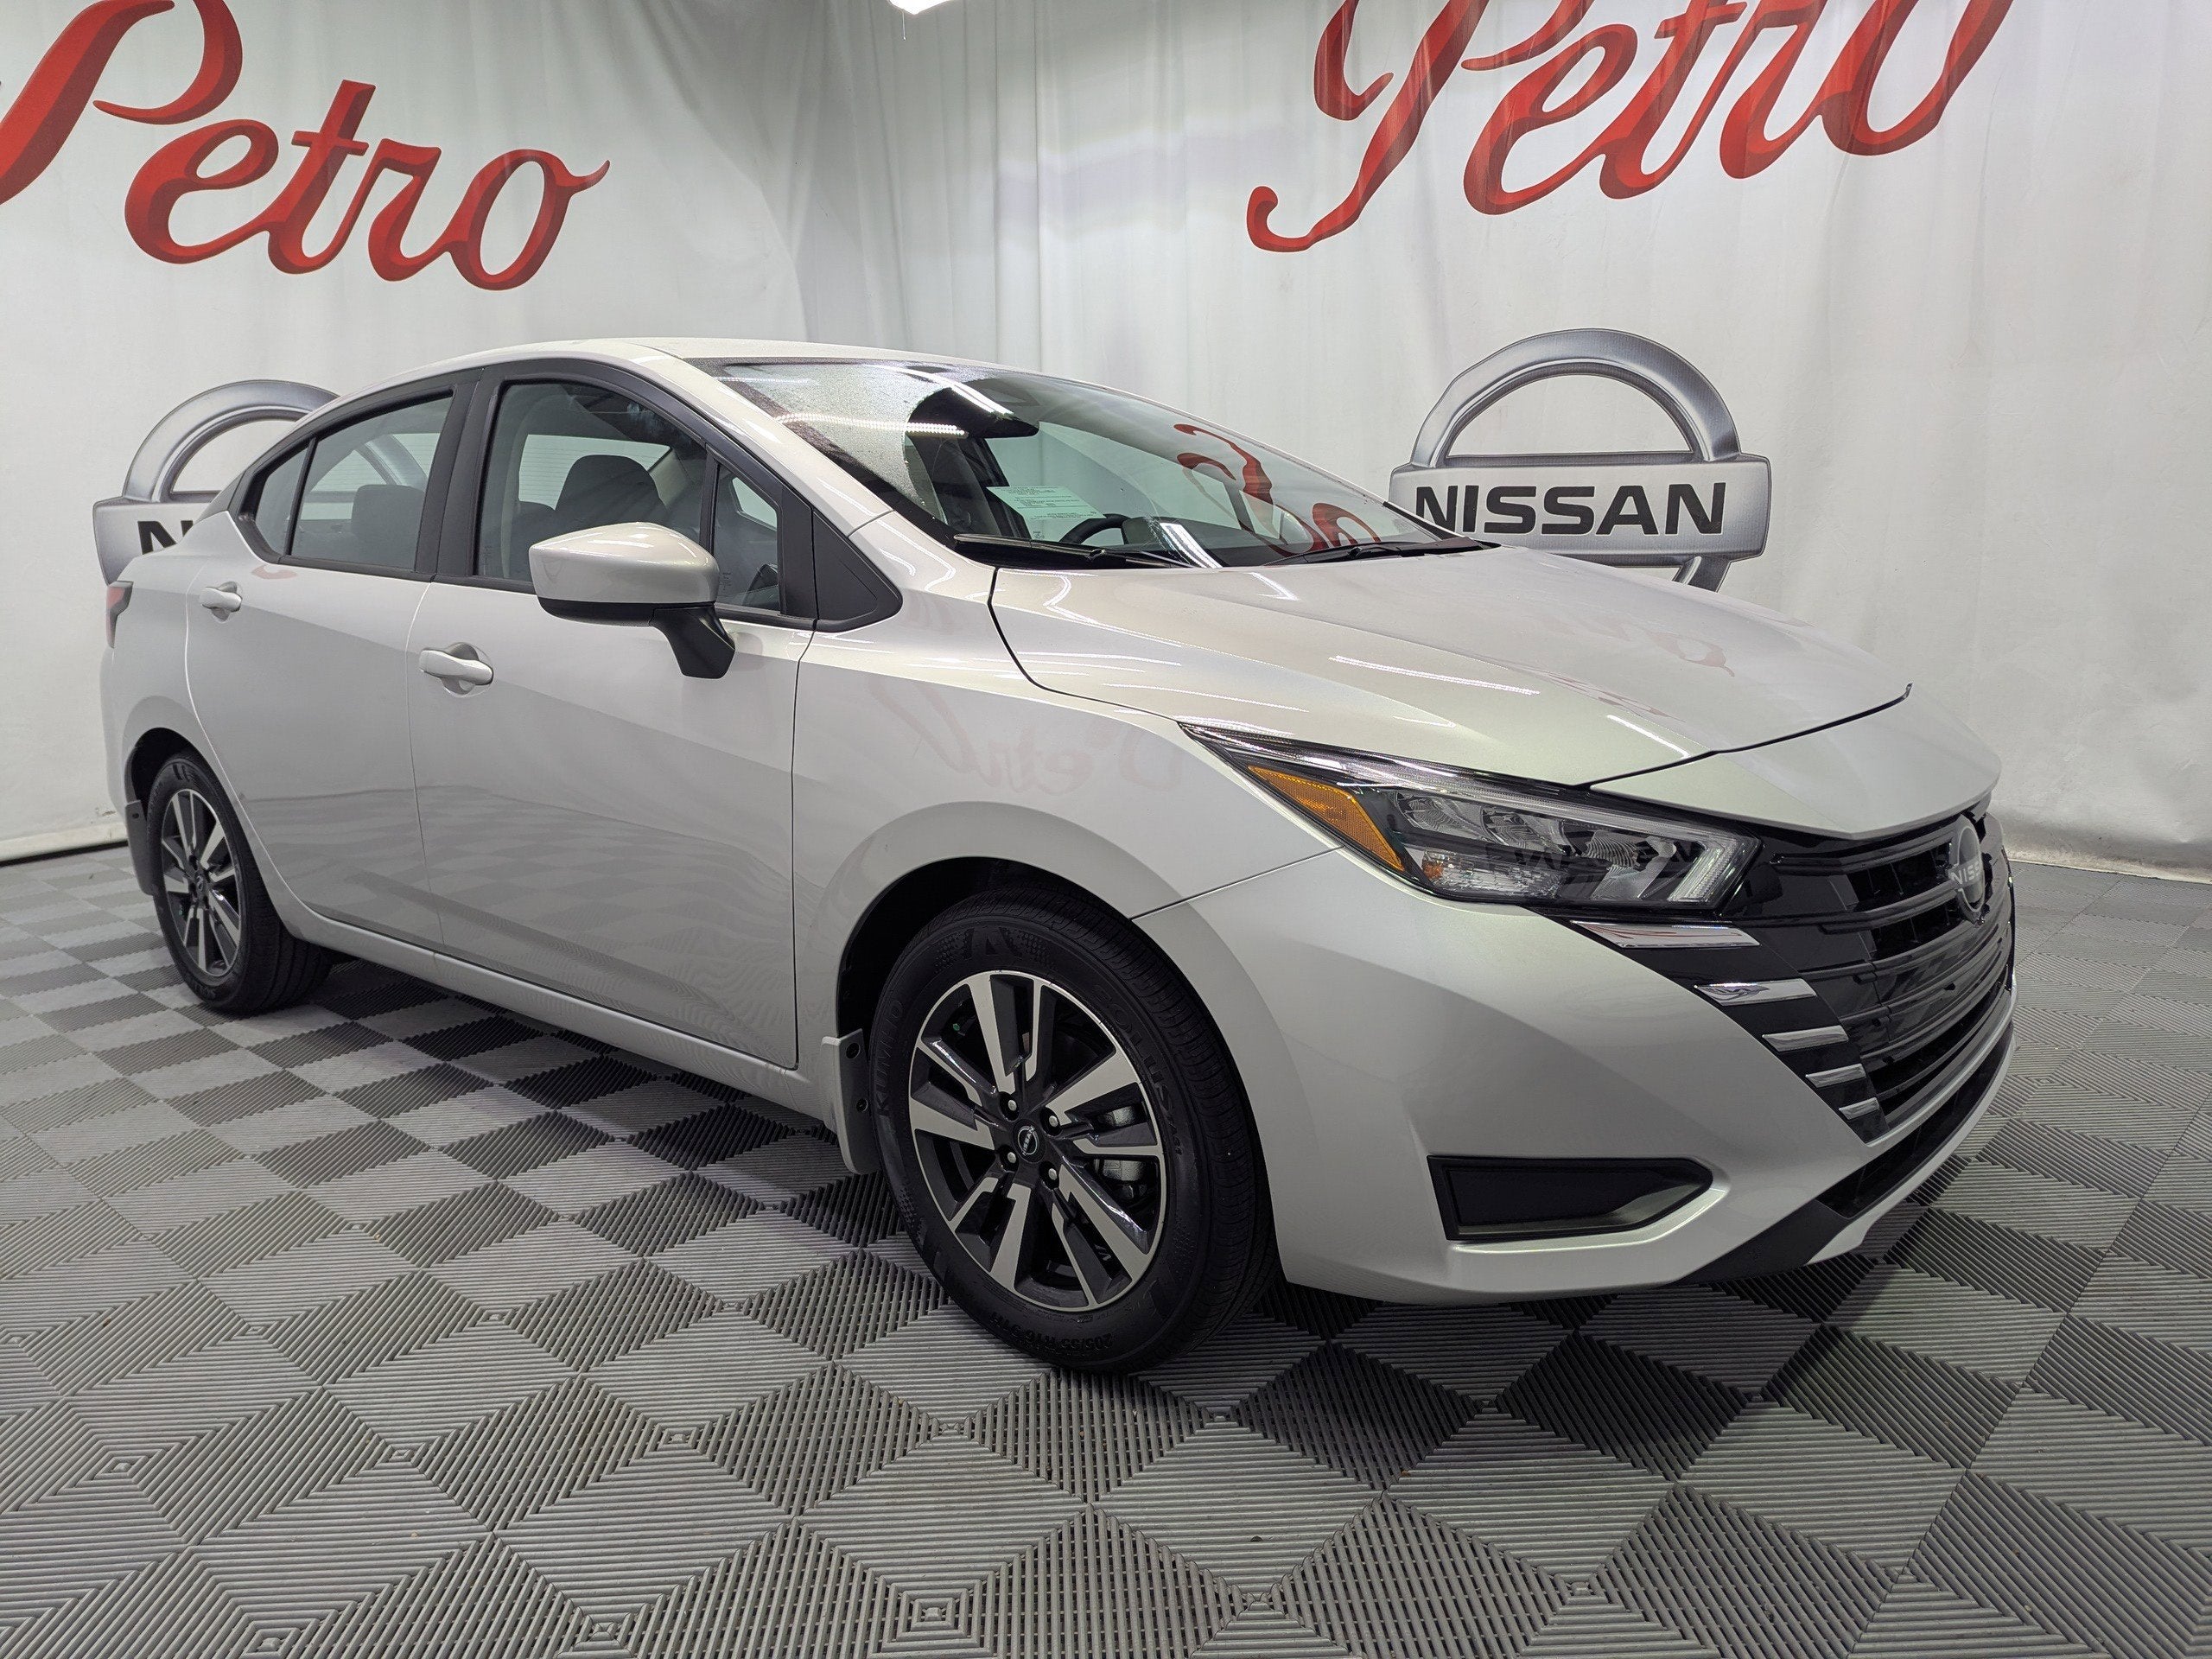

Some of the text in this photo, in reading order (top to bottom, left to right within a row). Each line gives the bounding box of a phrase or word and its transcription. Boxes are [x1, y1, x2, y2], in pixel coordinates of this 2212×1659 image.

[0, 0, 610, 291] Petro
[1245, 0, 2012, 253] Petro
[1415, 482, 1726, 535] NISSAN
[1950, 861, 1980, 884] NISS
[875, 995, 905, 1118] KUMHO
